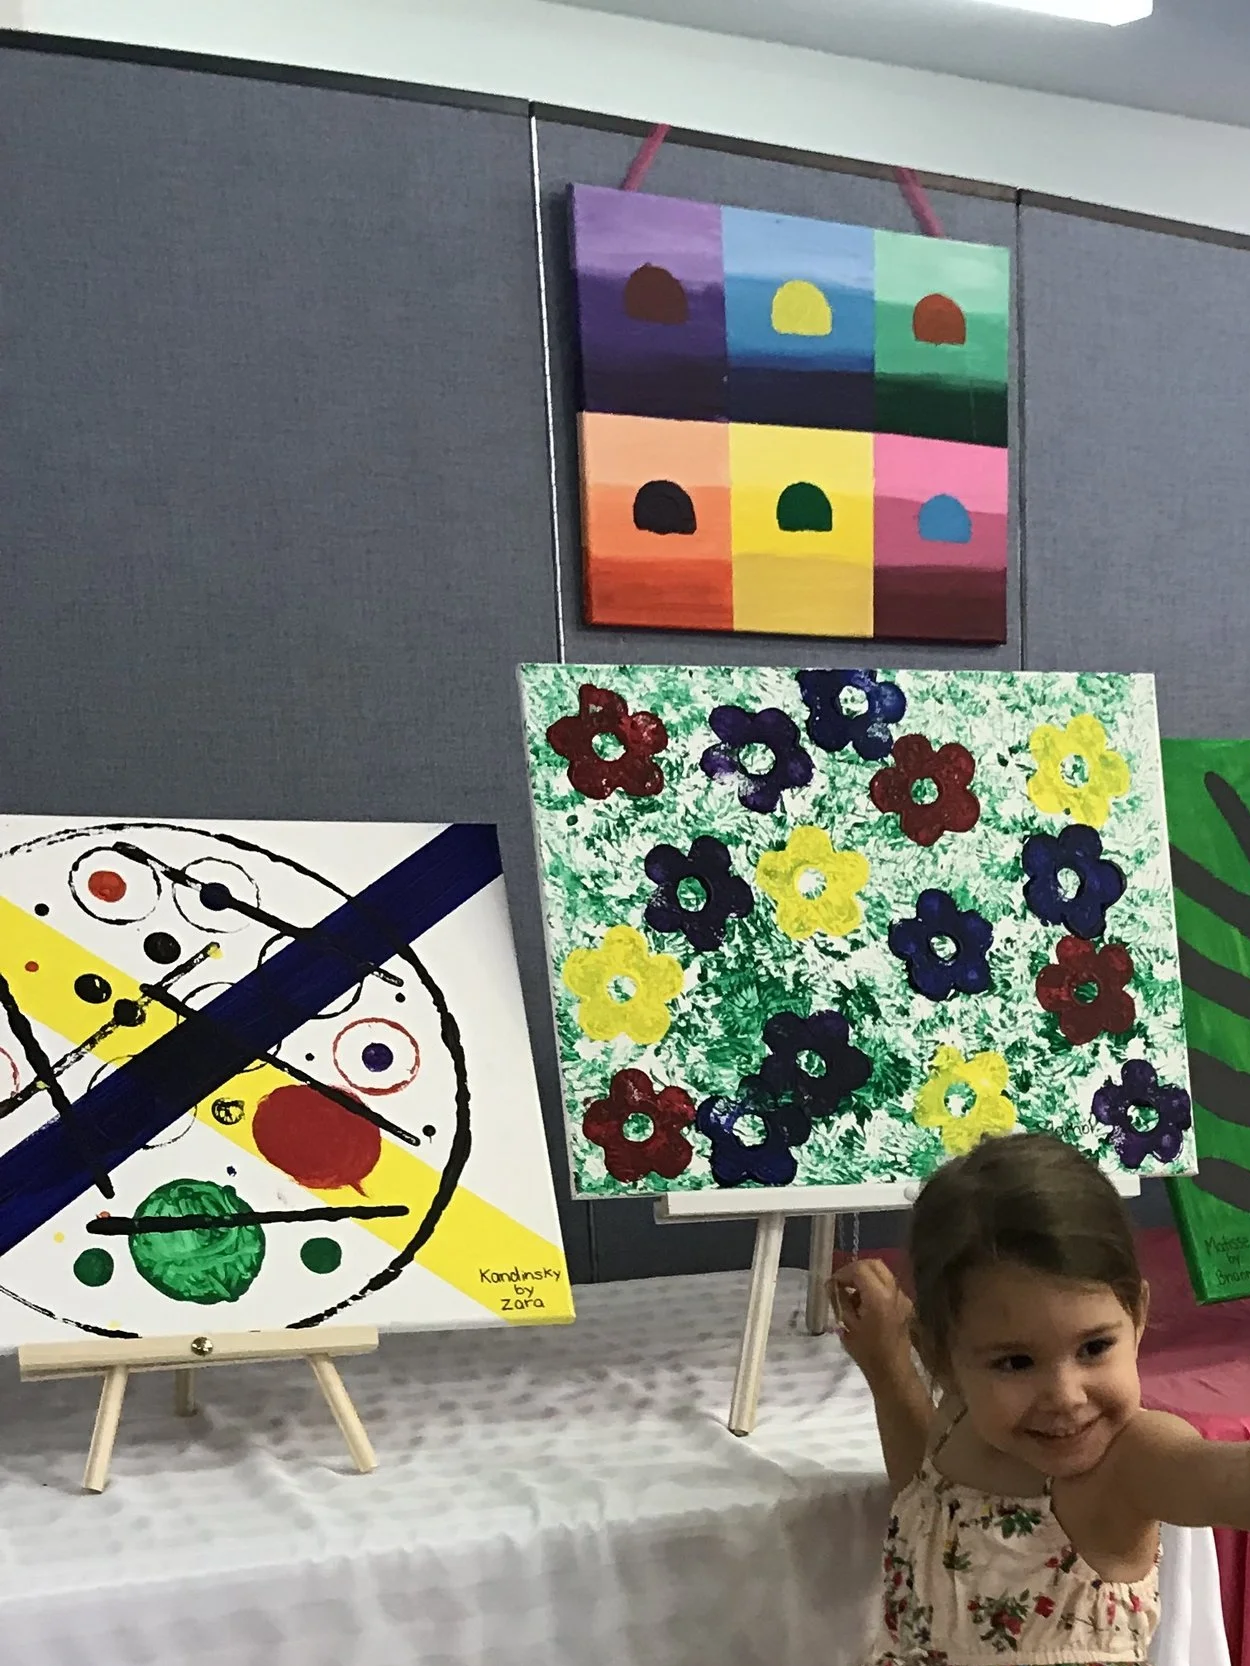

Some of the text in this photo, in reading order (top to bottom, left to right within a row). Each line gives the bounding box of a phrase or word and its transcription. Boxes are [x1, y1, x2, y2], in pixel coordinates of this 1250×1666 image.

[1204, 1234, 1250, 1256] Matisse
[1226, 1252, 1241, 1266] by
[479, 1266, 561, 1284] Kandinsky
[514, 1284, 534, 1298] by
[500, 1298, 545, 1311] Zara
